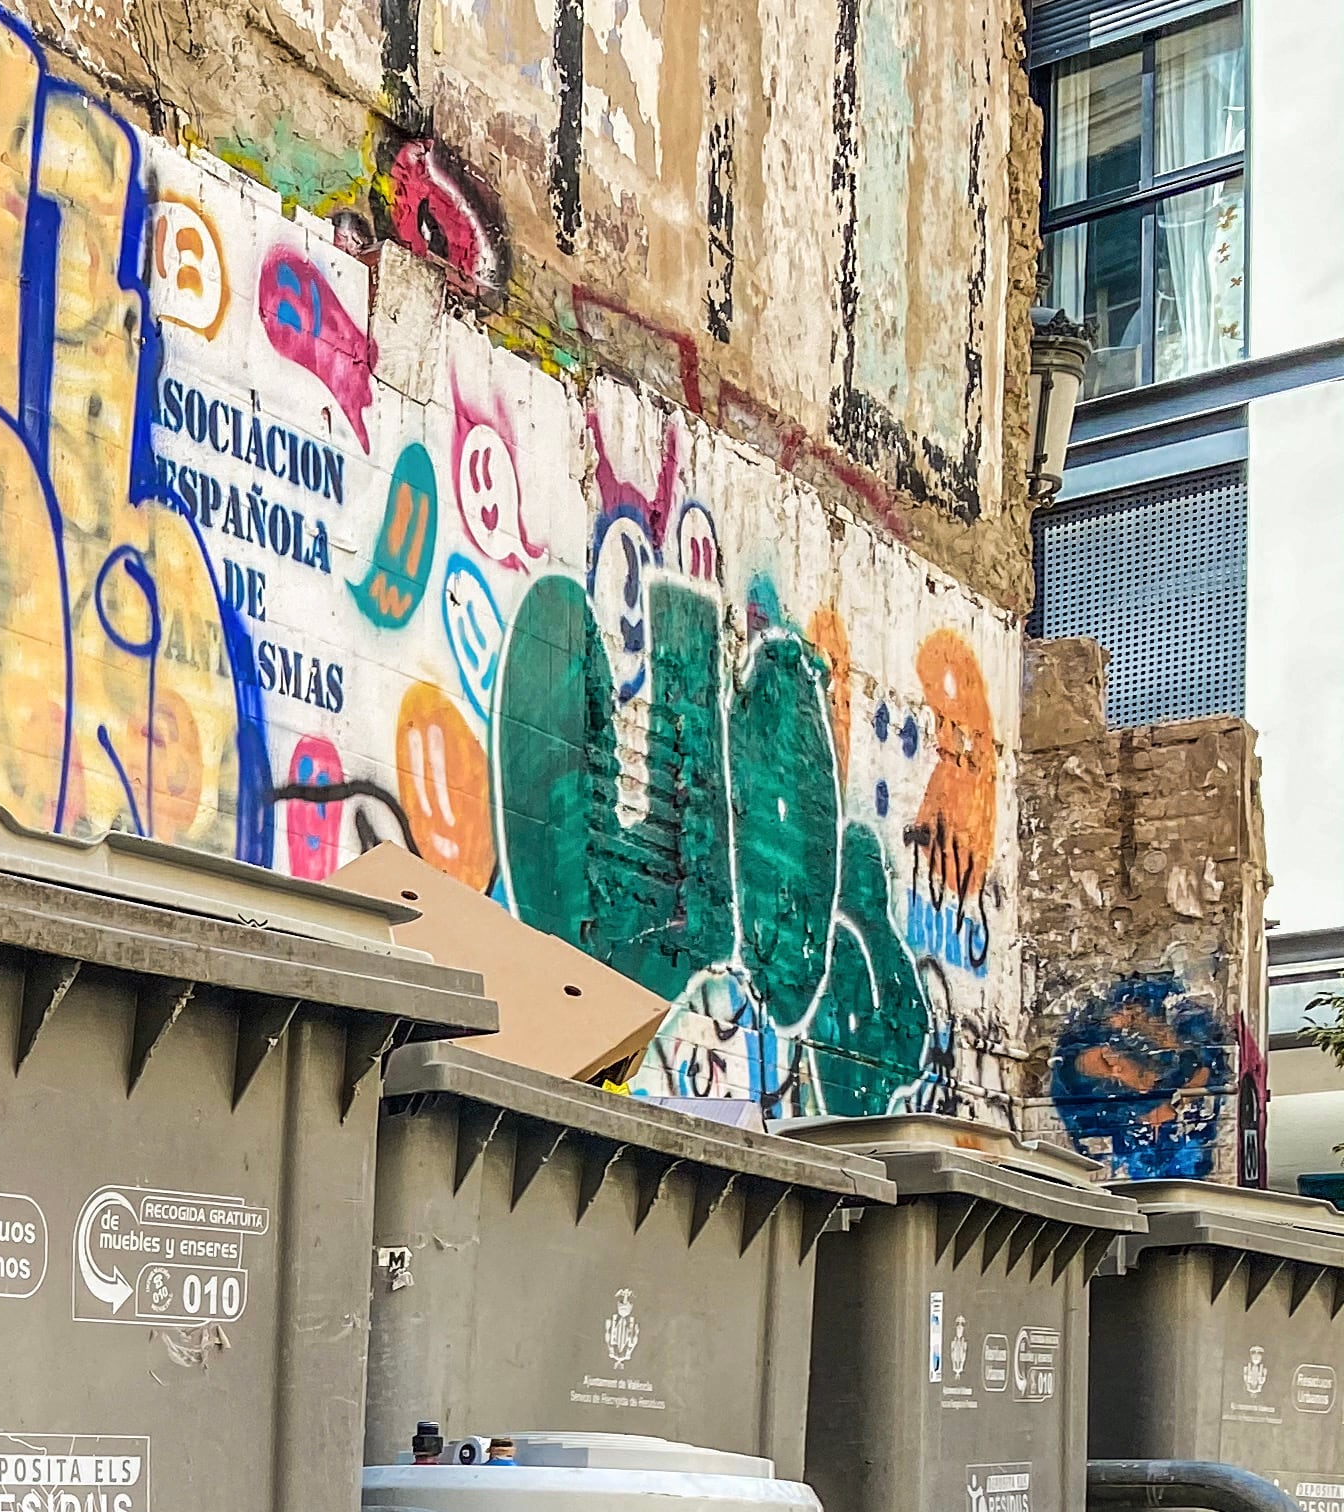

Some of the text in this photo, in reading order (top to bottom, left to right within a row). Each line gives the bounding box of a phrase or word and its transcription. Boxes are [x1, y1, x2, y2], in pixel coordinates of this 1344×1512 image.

[157, 377, 344, 505] SOCIACION
[223, 557, 266, 622] DE
[101, 1210, 120, 1230] de
[145, 1202, 264, 1228] RECOGIDA GRATUITA
[99, 1231, 238, 1259] muebles y enseres
[182, 1274, 240, 1316] 010
[95, 1459, 131, 1483] ELS
